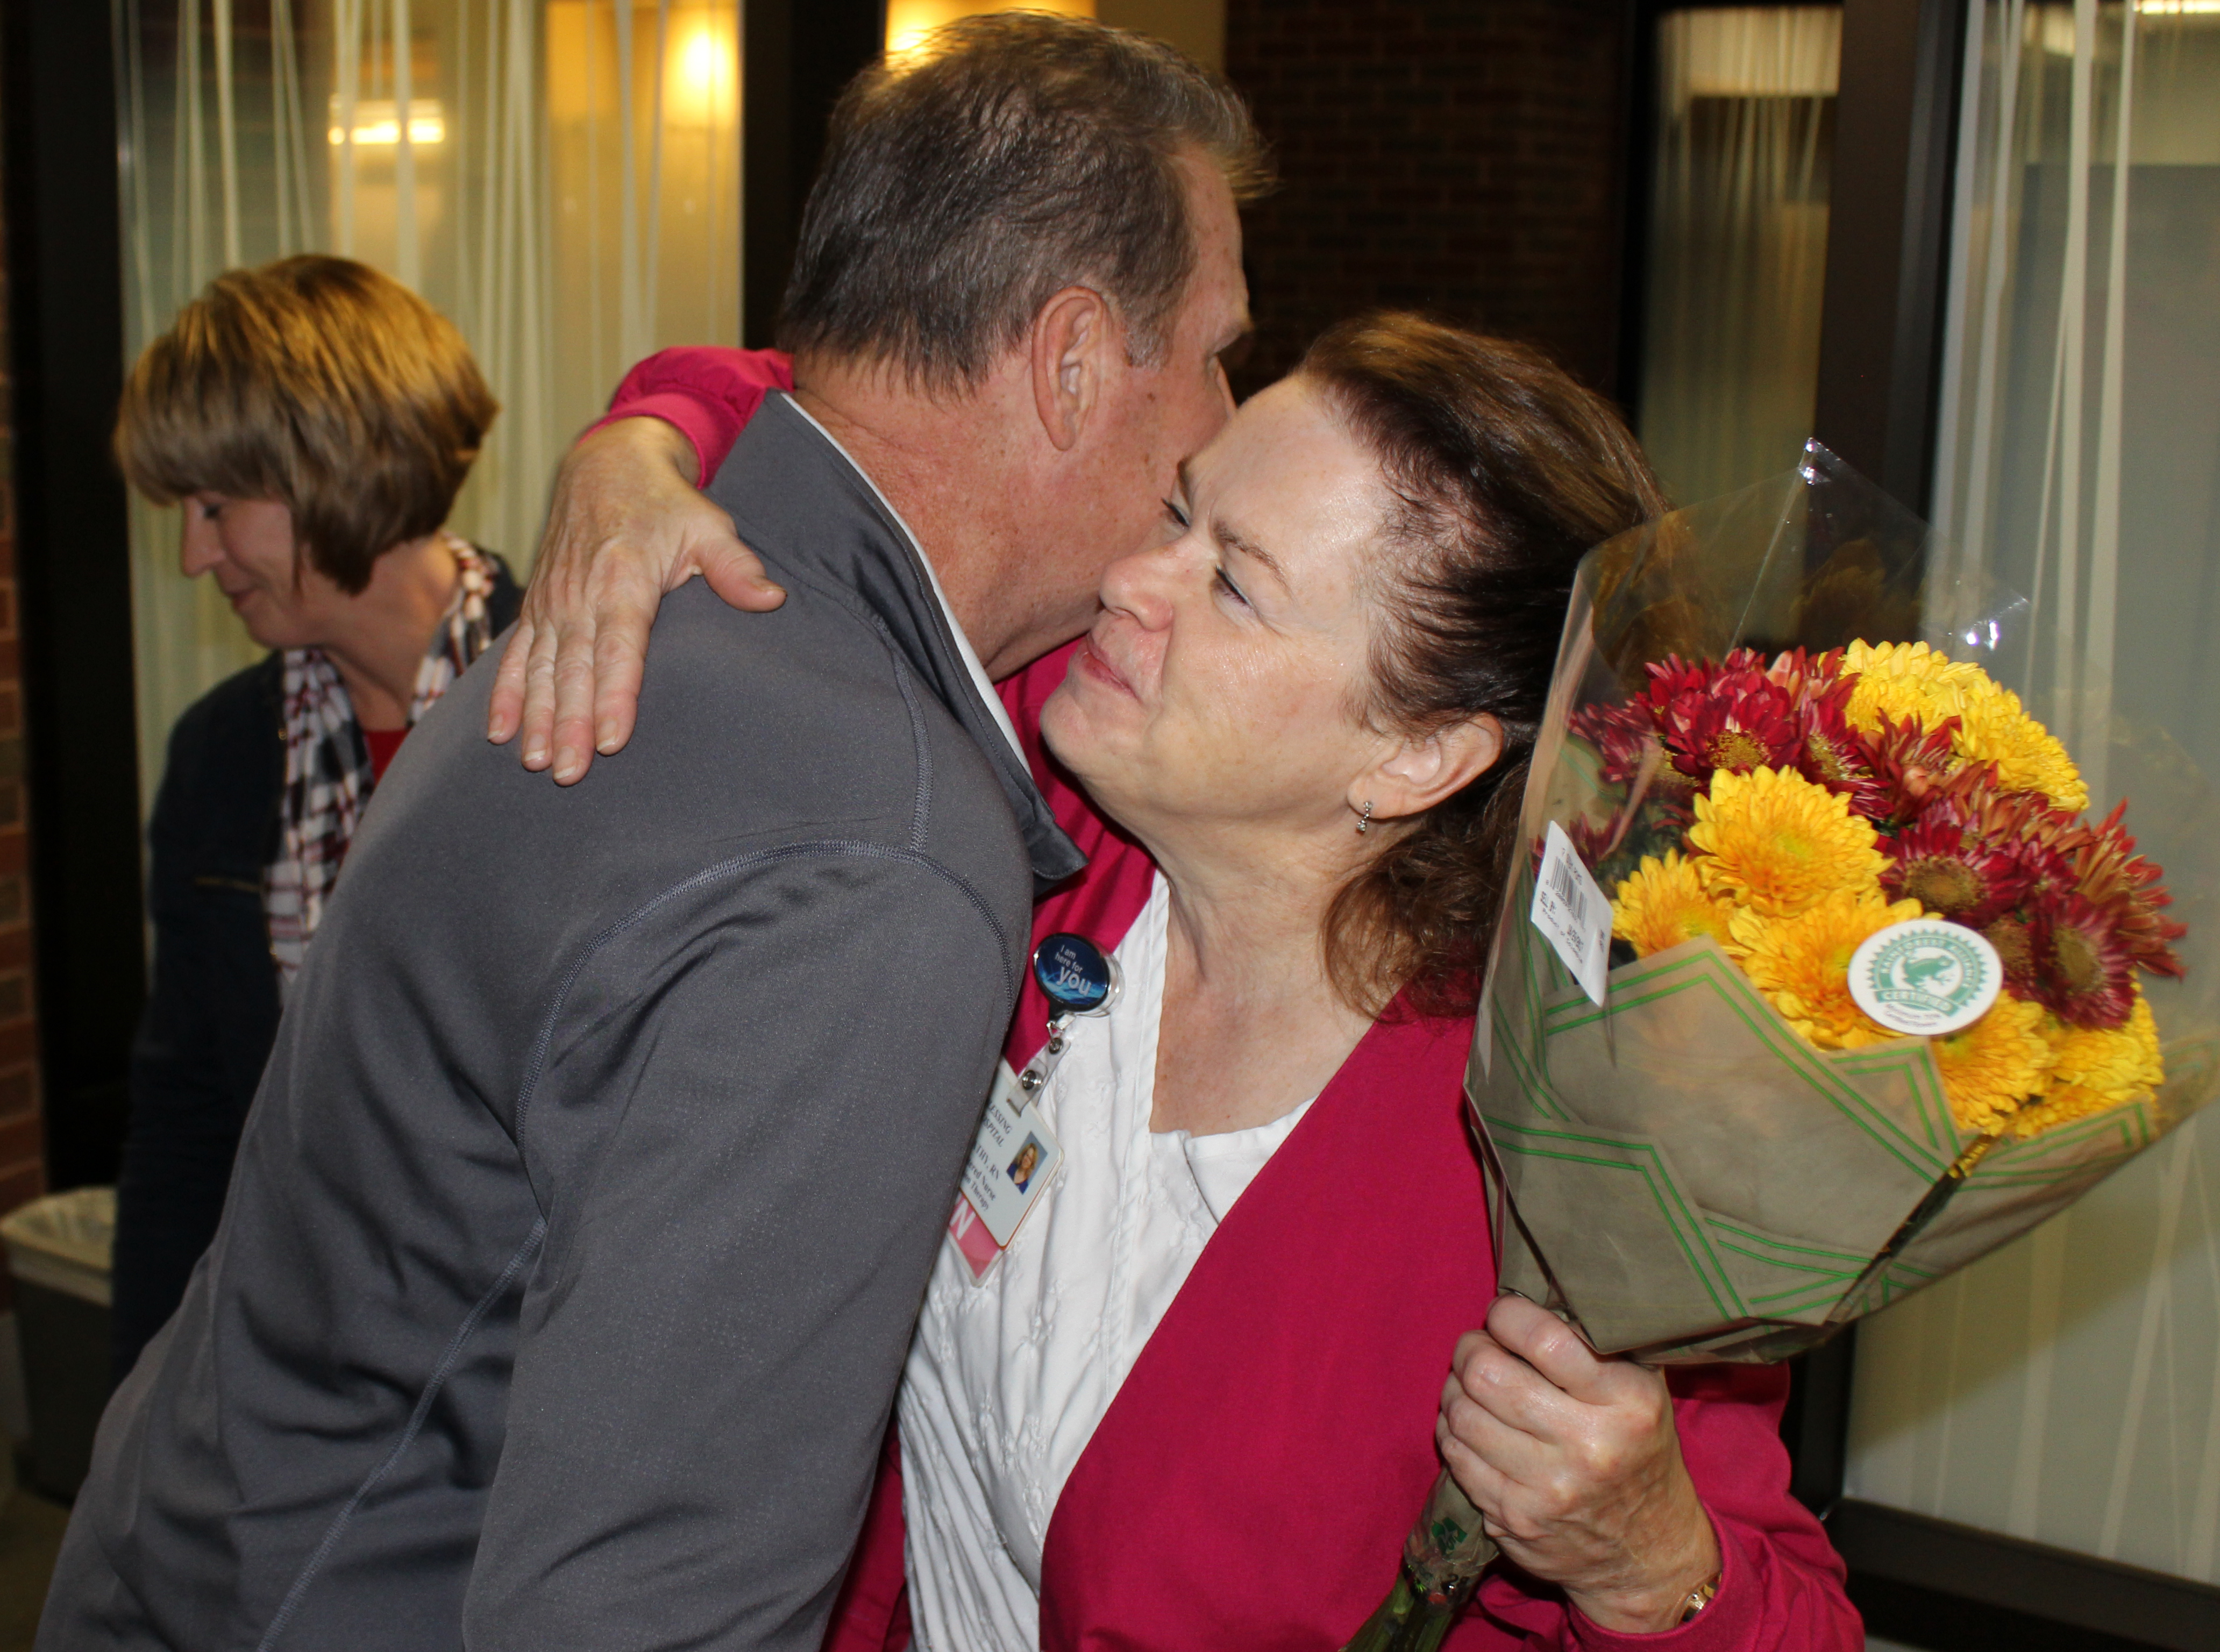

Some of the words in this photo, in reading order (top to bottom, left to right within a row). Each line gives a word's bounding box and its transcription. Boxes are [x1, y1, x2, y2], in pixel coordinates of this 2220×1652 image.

[1055, 951, 1071, 967] here
[1072, 961, 1084, 973] for
[1064, 949, 1076, 960] am
[1880, 938, 1946, 974] RAINFOREST
[1056, 966, 1092, 996] you
[1883, 991, 1953, 1012] CERTIFIED
[988, 1101, 1012, 1134] LESSING
[990, 1164, 999, 1181] RN
[971, 1181, 989, 1211] Therapy
[983, 1176, 996, 1201] Nurse
[949, 1192, 977, 1240] N
